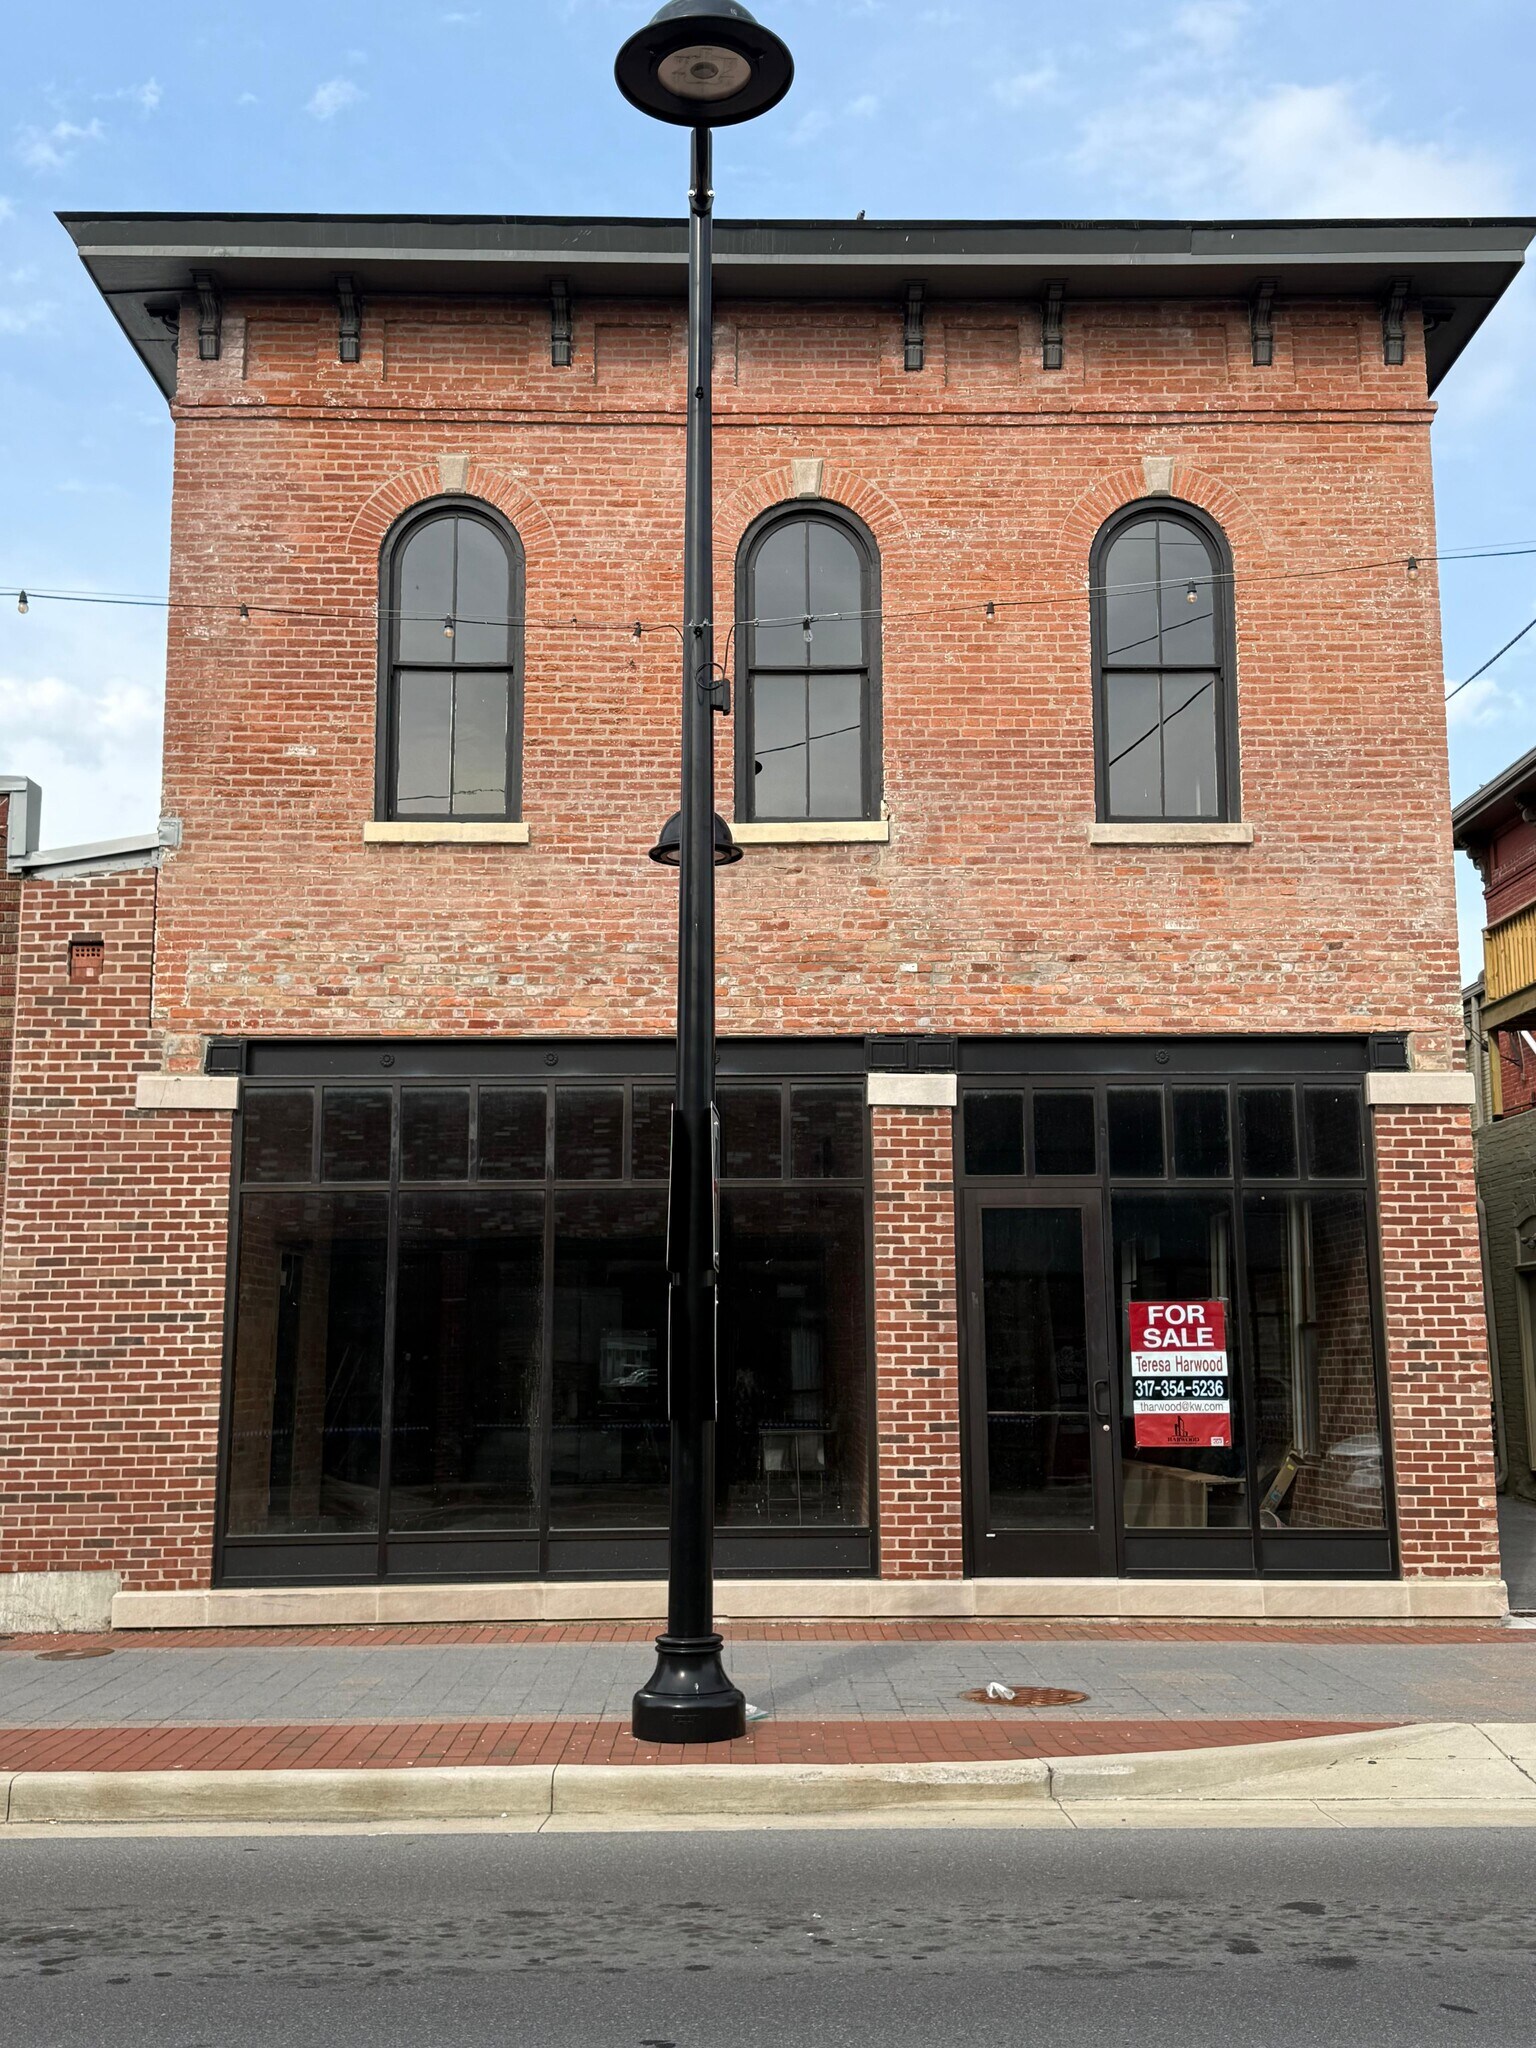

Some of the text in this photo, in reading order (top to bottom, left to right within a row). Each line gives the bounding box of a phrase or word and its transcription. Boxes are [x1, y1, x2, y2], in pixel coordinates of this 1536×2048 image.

[1148, 1305, 1205, 1325] FOR
[1143, 1327, 1214, 1348] SALE
[1136, 1356, 1223, 1372] Teresa Harwood
[1135, 1380, 1224, 1397] 317-354-5236
[1141, 1401, 1224, 1412] tharwood@kw.com
